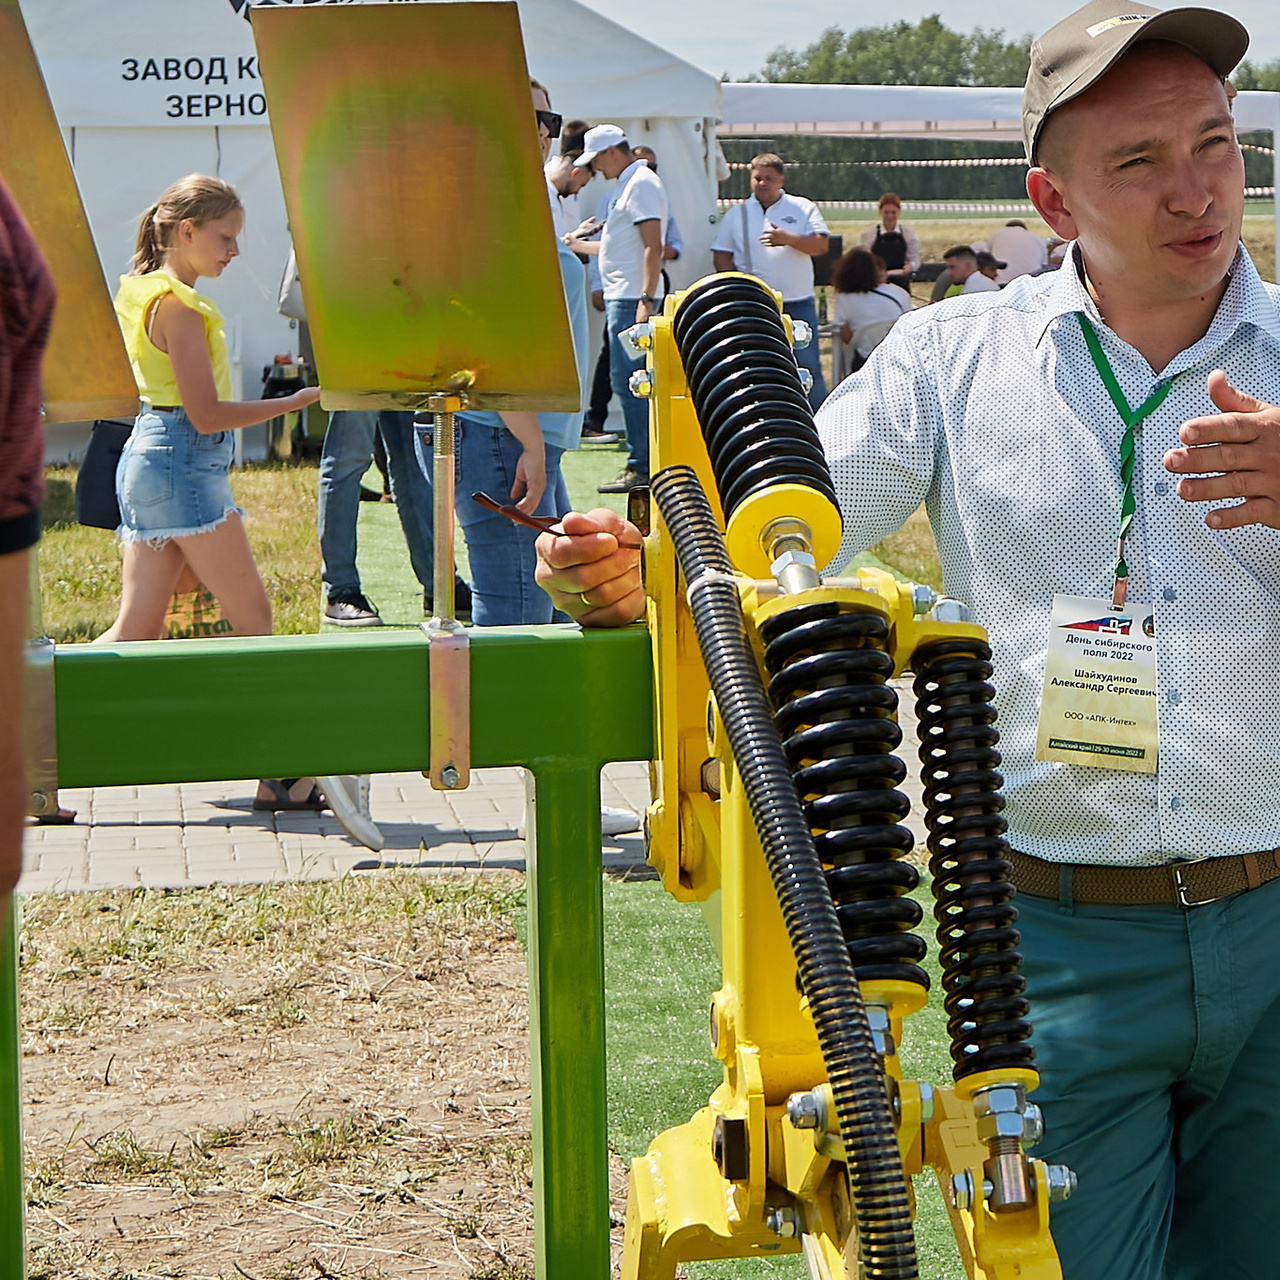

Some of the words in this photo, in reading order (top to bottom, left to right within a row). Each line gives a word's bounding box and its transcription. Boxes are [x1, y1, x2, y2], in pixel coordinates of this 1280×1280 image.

[121, 57, 228, 85] ЗАВОД
[237, 56, 263, 80] К
[166, 93, 267, 118] ЗЕРНО
[1066, 634, 1092, 645] День
[1094, 638, 1153, 652] сибирского
[1083, 648, 1108, 658] поля
[1110, 650, 1134, 661] 2022
[1074, 669, 1138, 684] Шайхудинов
[1050, 677, 1105, 693] Александр
[1106, 684, 1157, 698] Сергеевич
[1064, 711, 1084, 720] ООО
